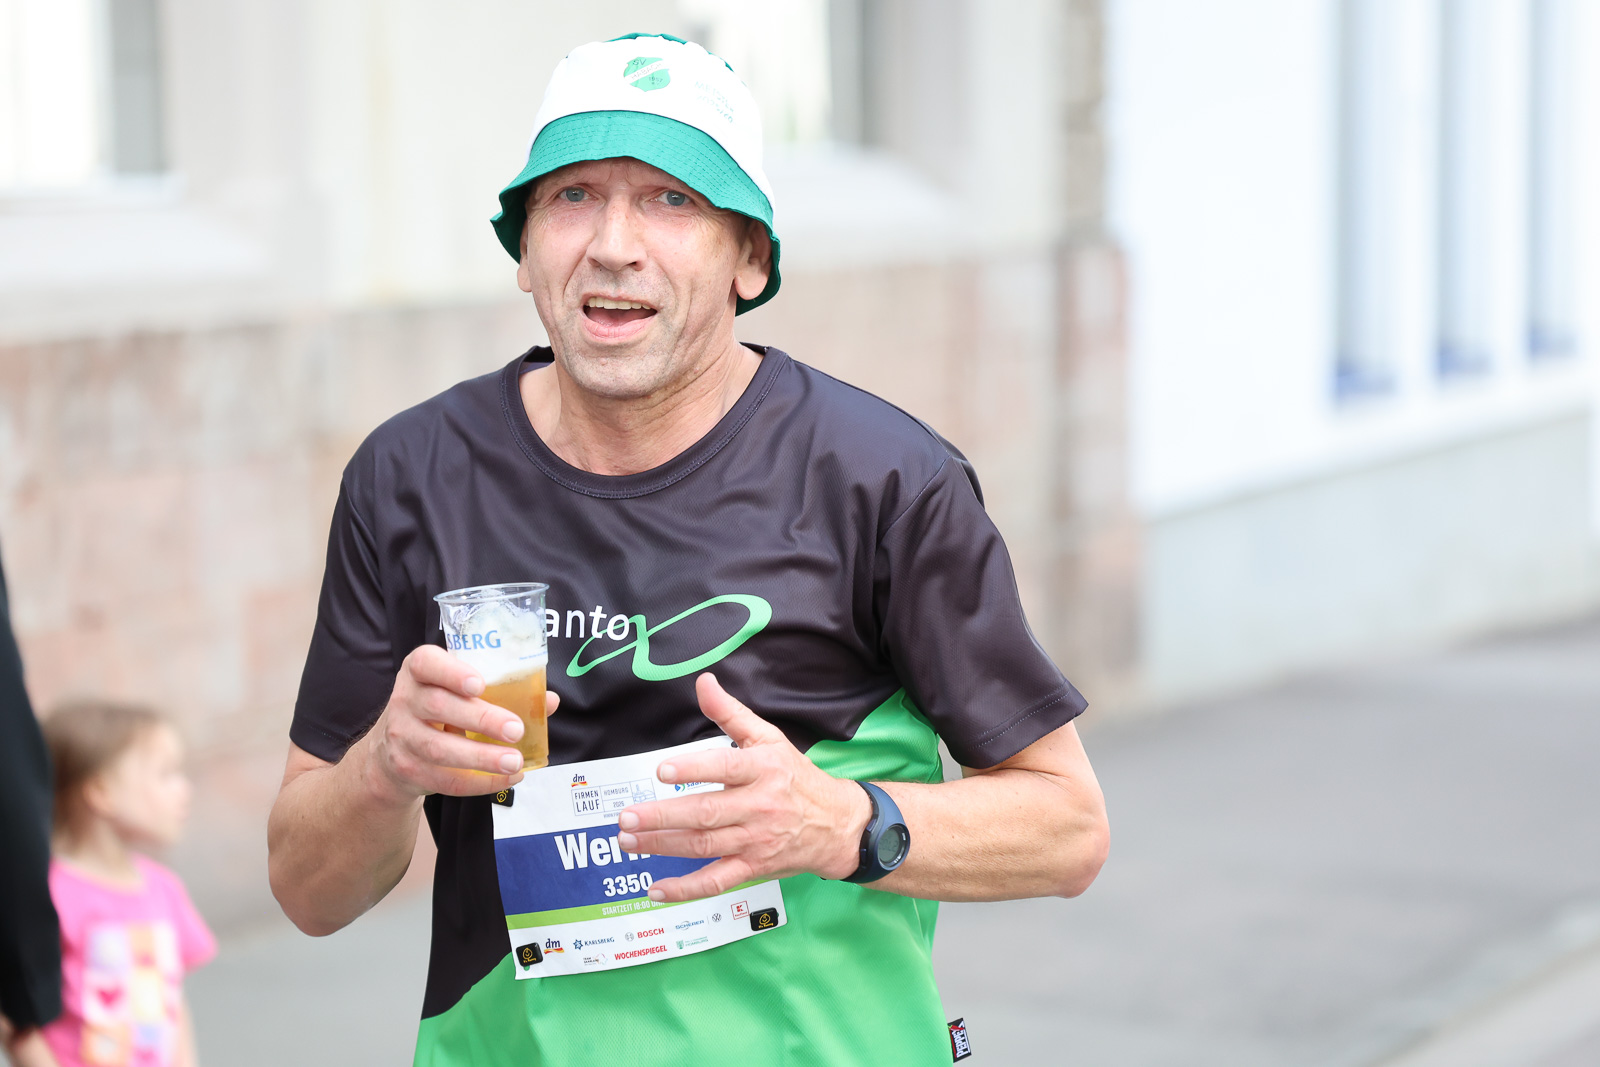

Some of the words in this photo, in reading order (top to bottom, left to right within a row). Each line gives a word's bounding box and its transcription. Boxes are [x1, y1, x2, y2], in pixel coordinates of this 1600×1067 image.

[572, 773, 585, 782] dm
[574, 790, 599, 800] FIRMEN
[603, 787, 629, 796] HOMBURG
[575, 799, 600, 813] LAUF
[603, 871, 652, 897] 3350
[602, 903, 633, 915] STARTZEIT
[633, 900, 651, 910] 18:00
[675, 919, 705, 930] SCHERER
[637, 928, 665, 938] BOSCH
[545, 938, 561, 948] dm
[584, 937, 615, 946] KARLSBERG
[614, 945, 667, 960] WOCHENSPIEGEL
